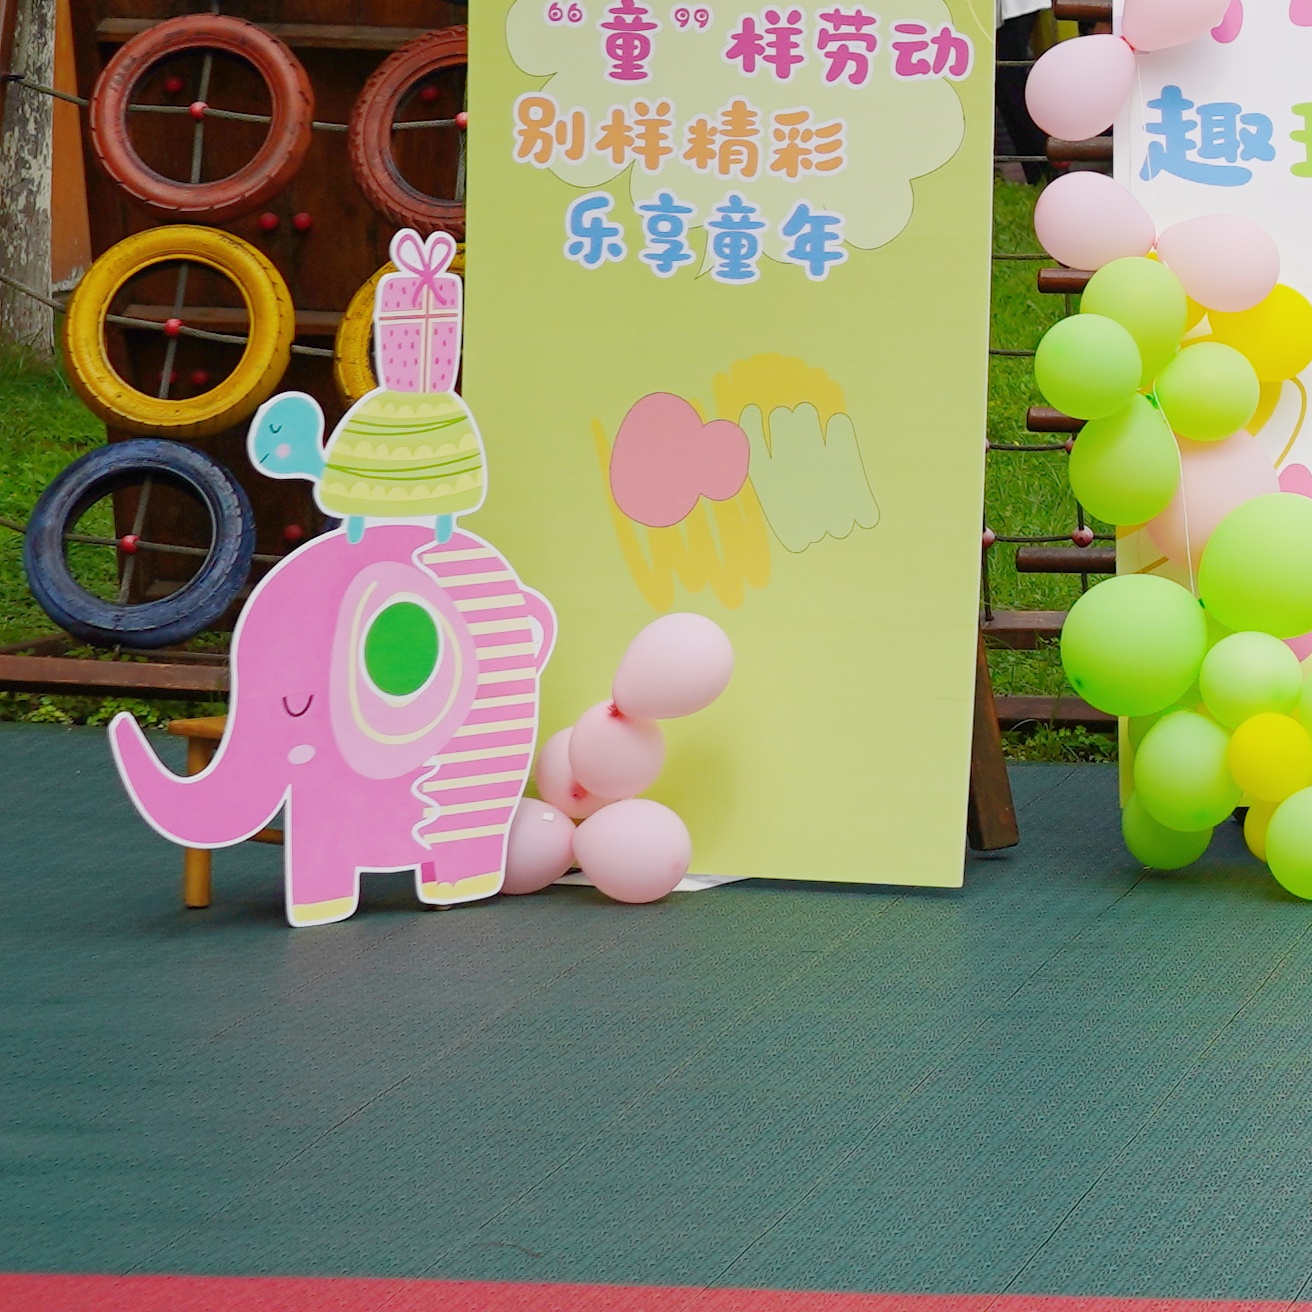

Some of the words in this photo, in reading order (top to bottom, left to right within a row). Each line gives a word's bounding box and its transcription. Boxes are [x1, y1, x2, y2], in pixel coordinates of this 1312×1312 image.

[516, 97, 844, 177] 别样精彩
[567, 193, 843, 280] 乐享童年
